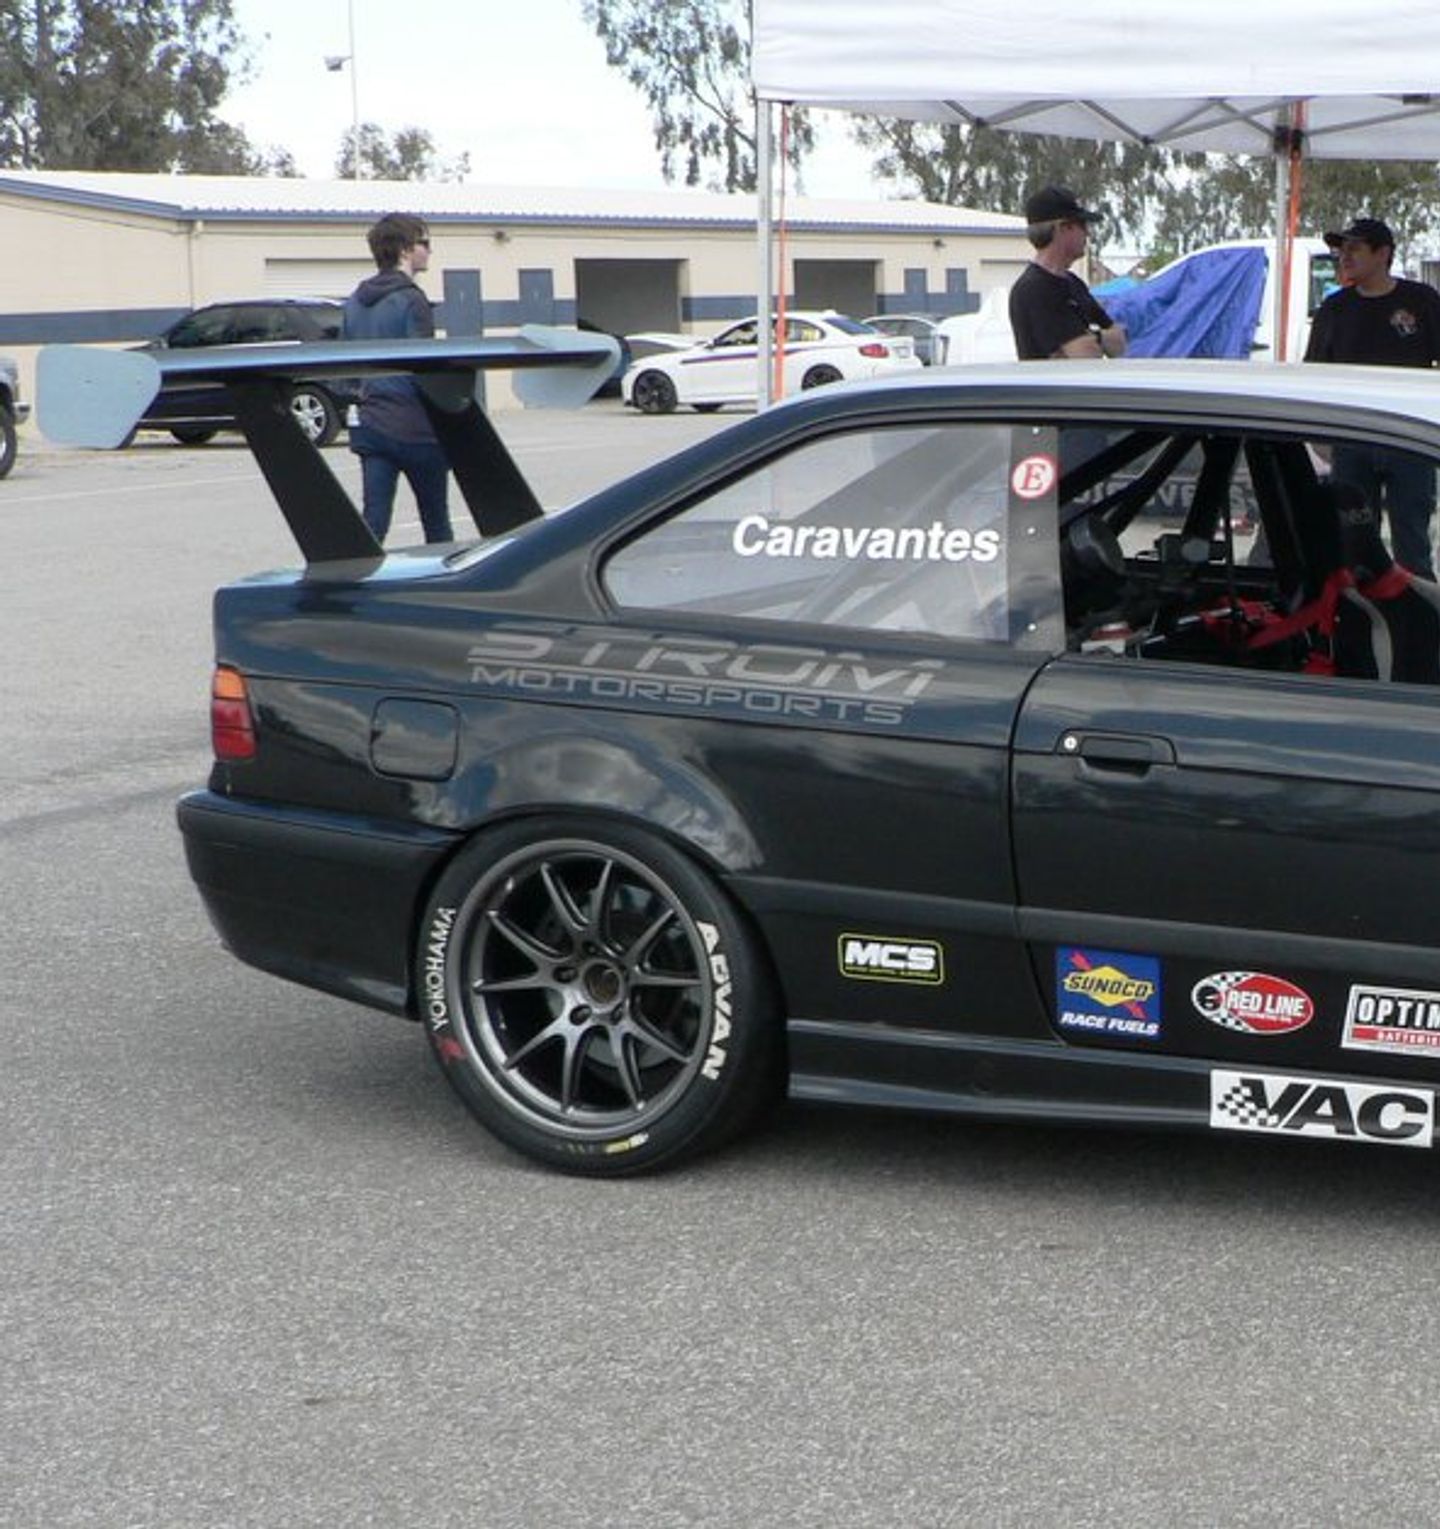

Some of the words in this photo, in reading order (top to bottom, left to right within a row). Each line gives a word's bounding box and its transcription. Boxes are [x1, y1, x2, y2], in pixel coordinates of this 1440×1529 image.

[1019, 462, 1046, 491] E
[732, 513, 1001, 562] Caravantes
[470, 665, 904, 725] MOTORSPORTS
[425, 906, 456, 1031] YOKOHAMA
[845, 939, 937, 971] MCS
[697, 920, 733, 1081] ADVAN
[1067, 973, 1150, 999] SUNOCO
[1227, 989, 1263, 1012] RED
[1264, 993, 1306, 1018] LINE
[1060, 1011, 1105, 1028] RACE
[1107, 1017, 1159, 1036] FUELS
[1238, 1077, 1429, 1140] VAC
